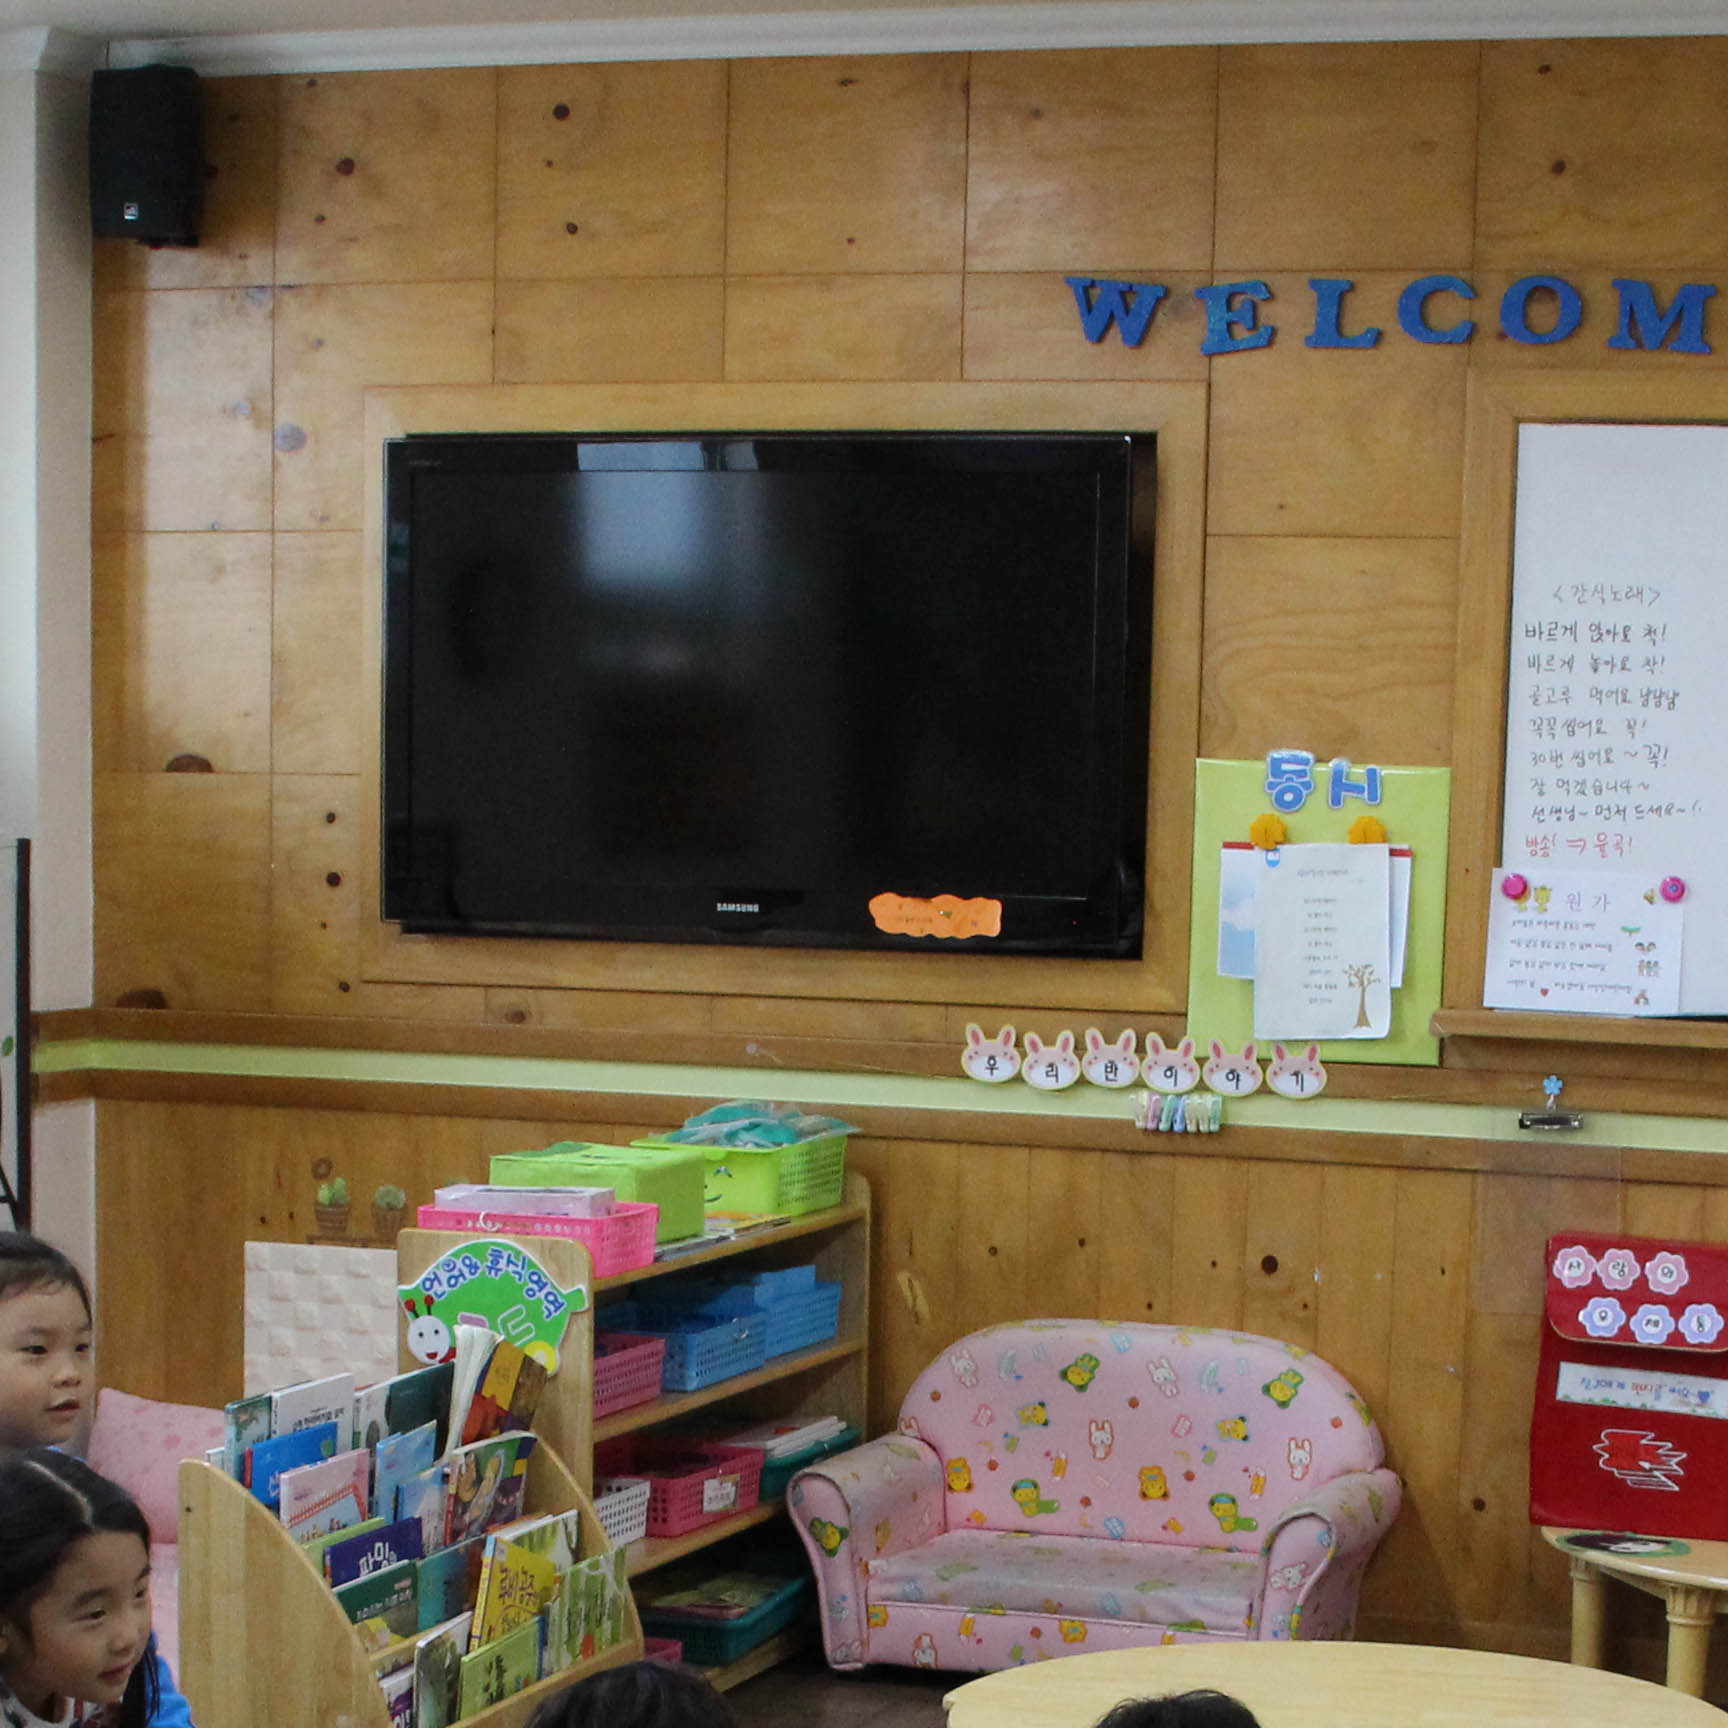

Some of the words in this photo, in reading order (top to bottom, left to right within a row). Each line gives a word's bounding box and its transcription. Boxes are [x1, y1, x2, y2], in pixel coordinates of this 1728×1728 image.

[1524, 620, 1578, 643] 바르게
[1588, 621, 1632, 643] 앉아요
[1527, 654, 1575, 674] 바르게
[1589, 686, 1632, 707] 먹어요
[1530, 751, 1564, 769] 30번
[1265, 749, 1383, 812] 동시
[1594, 804, 1627, 822] 먼저
[716, 902, 760, 913] SAMSUNG
